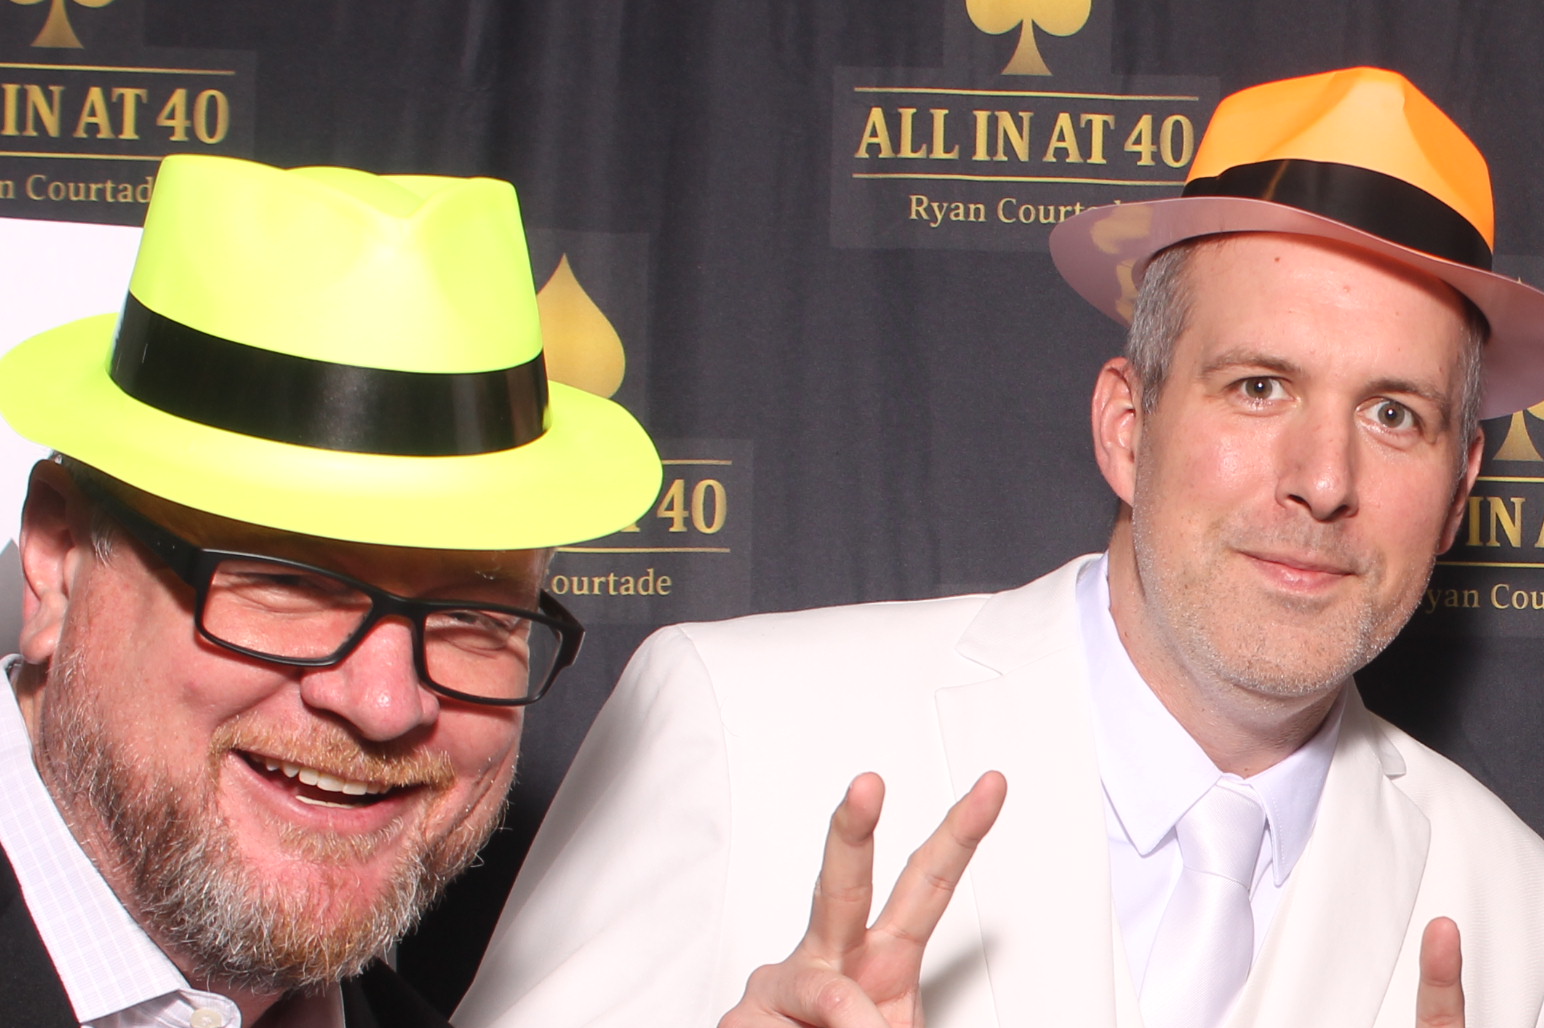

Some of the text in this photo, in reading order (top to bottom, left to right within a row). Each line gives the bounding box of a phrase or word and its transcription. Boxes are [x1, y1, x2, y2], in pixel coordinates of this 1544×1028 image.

[1, 83, 230, 144] IN AT 40
[854, 107, 1194, 168] ALL IN AT 40
[26, 174, 153, 203] Courtad
[910, 194, 986, 227] Ryan
[656, 478, 728, 534] 40
[1465, 496, 1526, 549] IN
[550, 567, 673, 596] ourtade
[1424, 587, 1480, 613] yan
